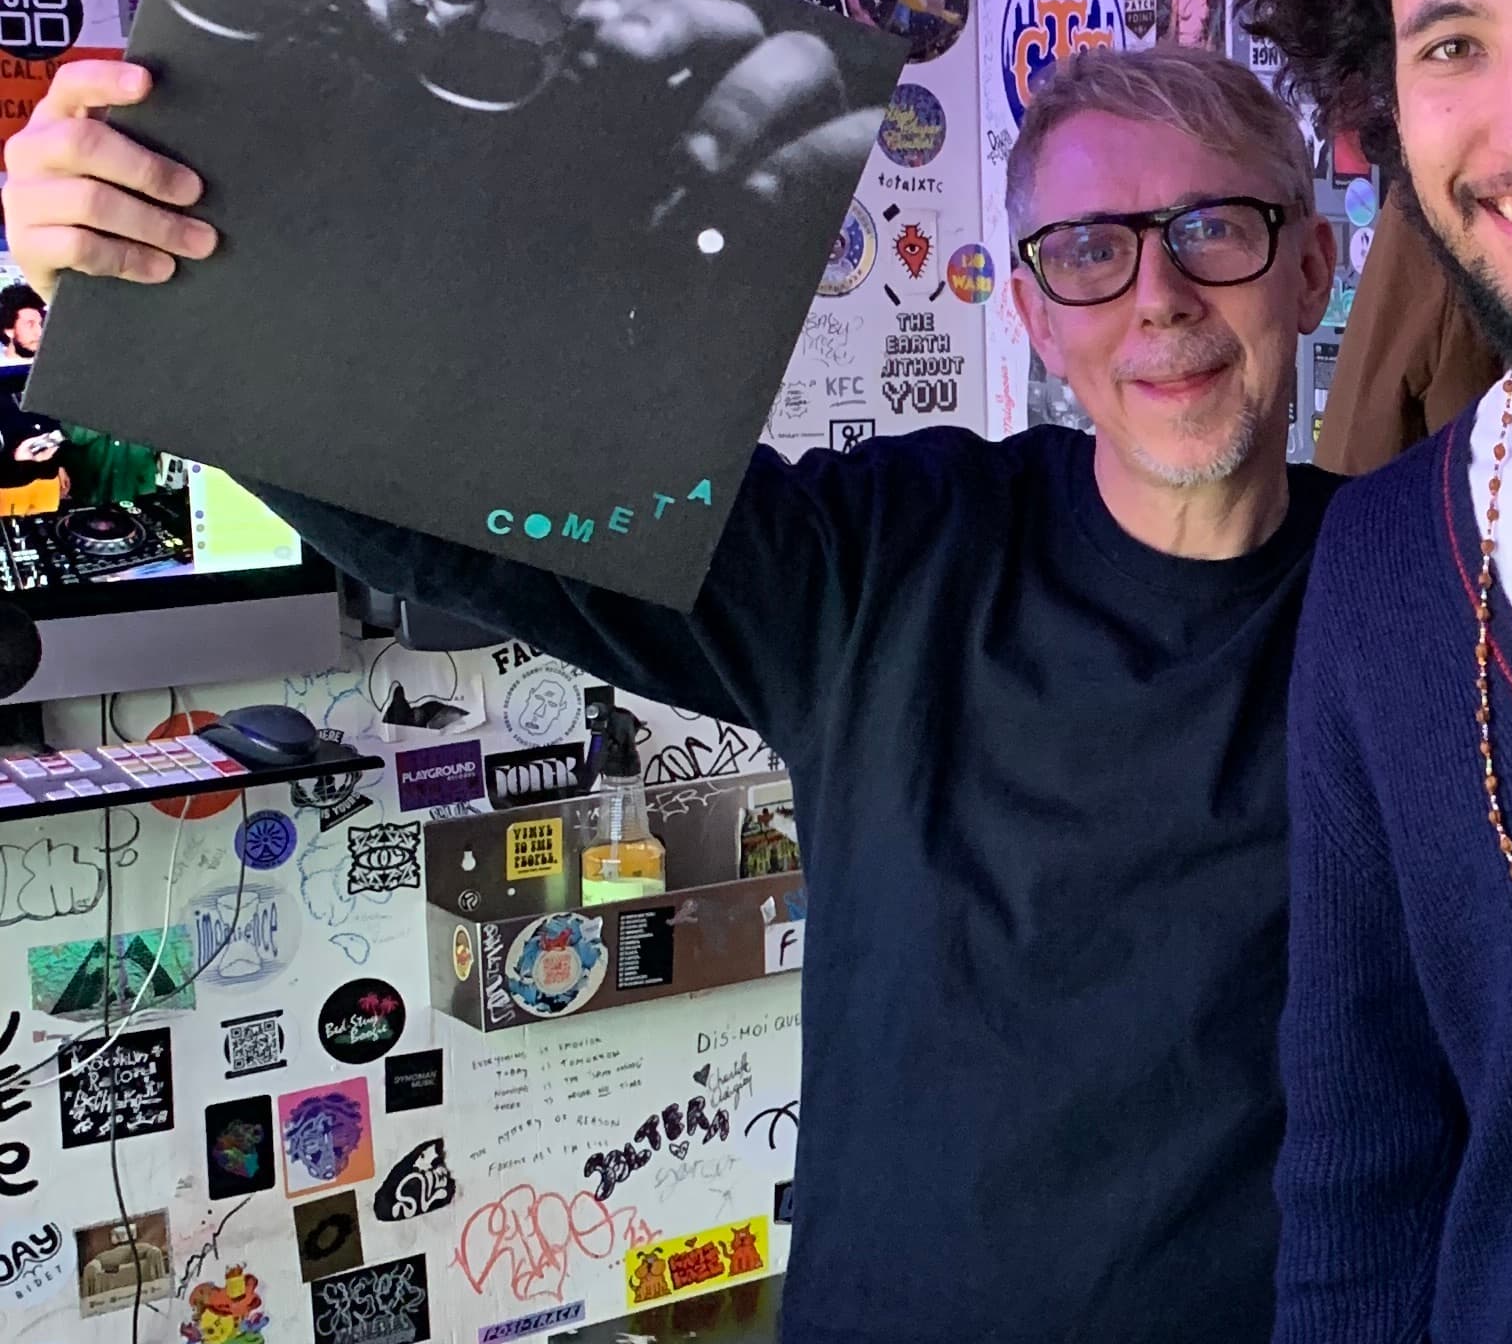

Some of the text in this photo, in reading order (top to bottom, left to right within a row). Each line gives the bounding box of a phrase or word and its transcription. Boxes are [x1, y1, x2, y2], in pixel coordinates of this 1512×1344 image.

[896, 312, 935, 333] THE
[885, 334, 951, 356] EARTH
[881, 356, 966, 379] WITHOUT
[882, 379, 959, 416] YOU
[486, 478, 713, 544] COMETA
[401, 760, 477, 785] PLAYGROUND
